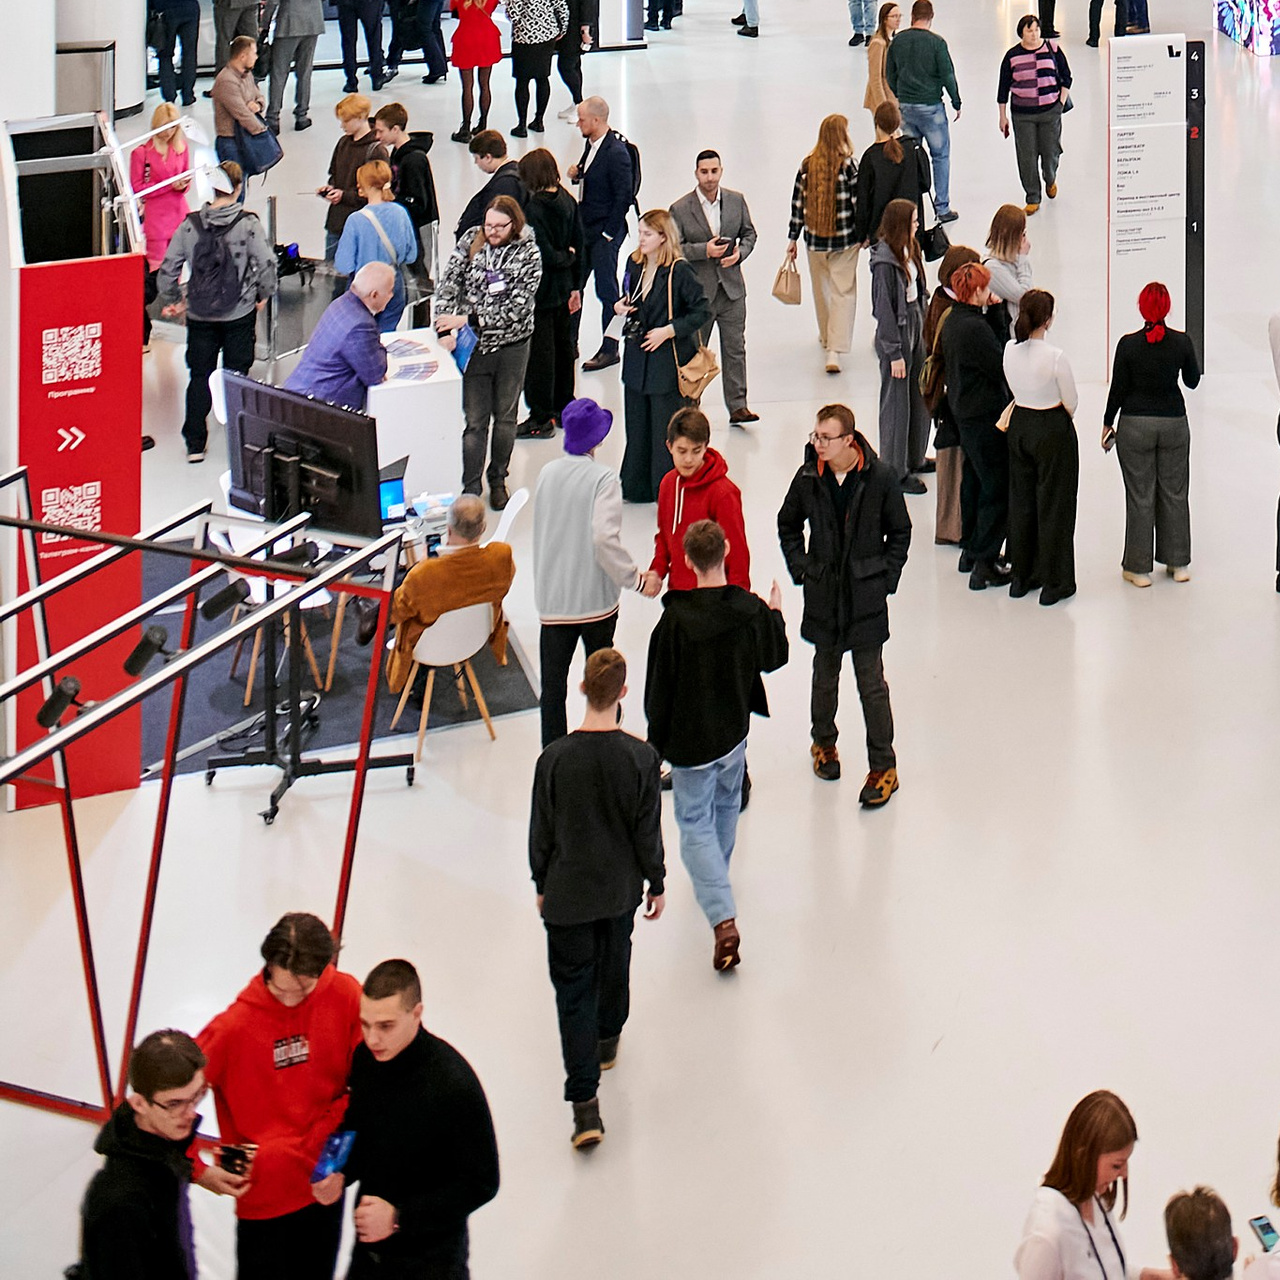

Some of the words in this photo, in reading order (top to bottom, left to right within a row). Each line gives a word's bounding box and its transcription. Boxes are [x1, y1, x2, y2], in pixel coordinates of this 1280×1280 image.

[1191, 51, 1199, 61] 4
[1191, 88, 1198, 99] 3
[1190, 126, 1200, 138] 2
[1192, 222, 1198, 232] 1
